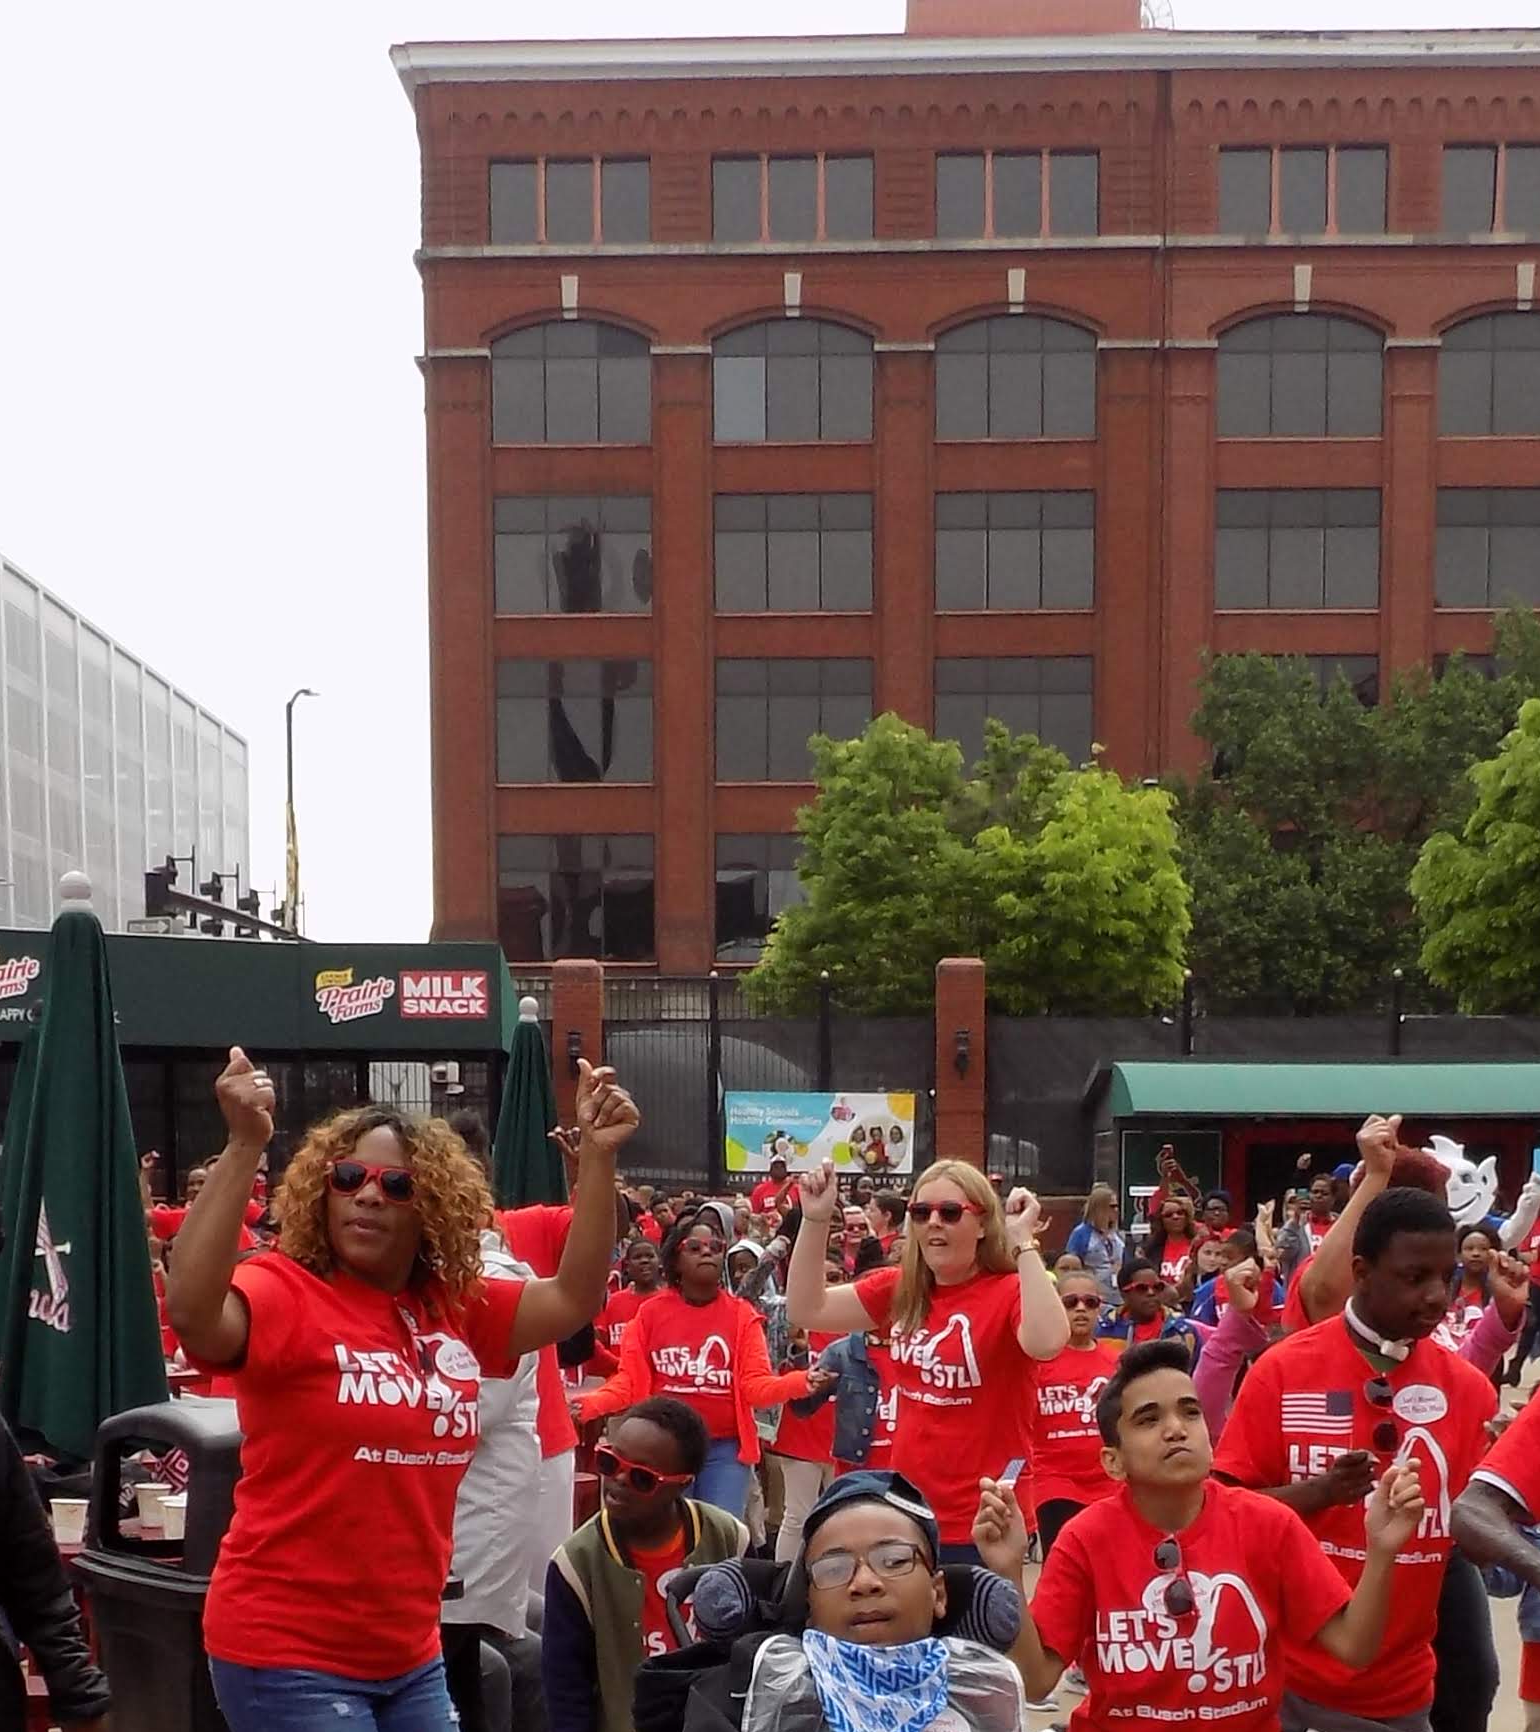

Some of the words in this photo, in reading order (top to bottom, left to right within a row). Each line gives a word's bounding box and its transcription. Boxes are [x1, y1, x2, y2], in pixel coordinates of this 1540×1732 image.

[315, 976, 395, 1012] Prairie
[402, 976, 486, 998] MILK
[328, 999, 383, 1024] Farms
[402, 999, 486, 1014] SNACK
[334, 1343, 406, 1376] LET'
[651, 1346, 691, 1366] LET'S
[1037, 1384, 1079, 1402] LET'S
[354, 1446, 383, 1464] At
[384, 1449, 433, 1466] Busch
[1096, 1609, 1178, 1643] LET'S
[1108, 1707, 1134, 1718] At
[1136, 1704, 1196, 1722] Busch
[1198, 1696, 1268, 1722] Stadium
